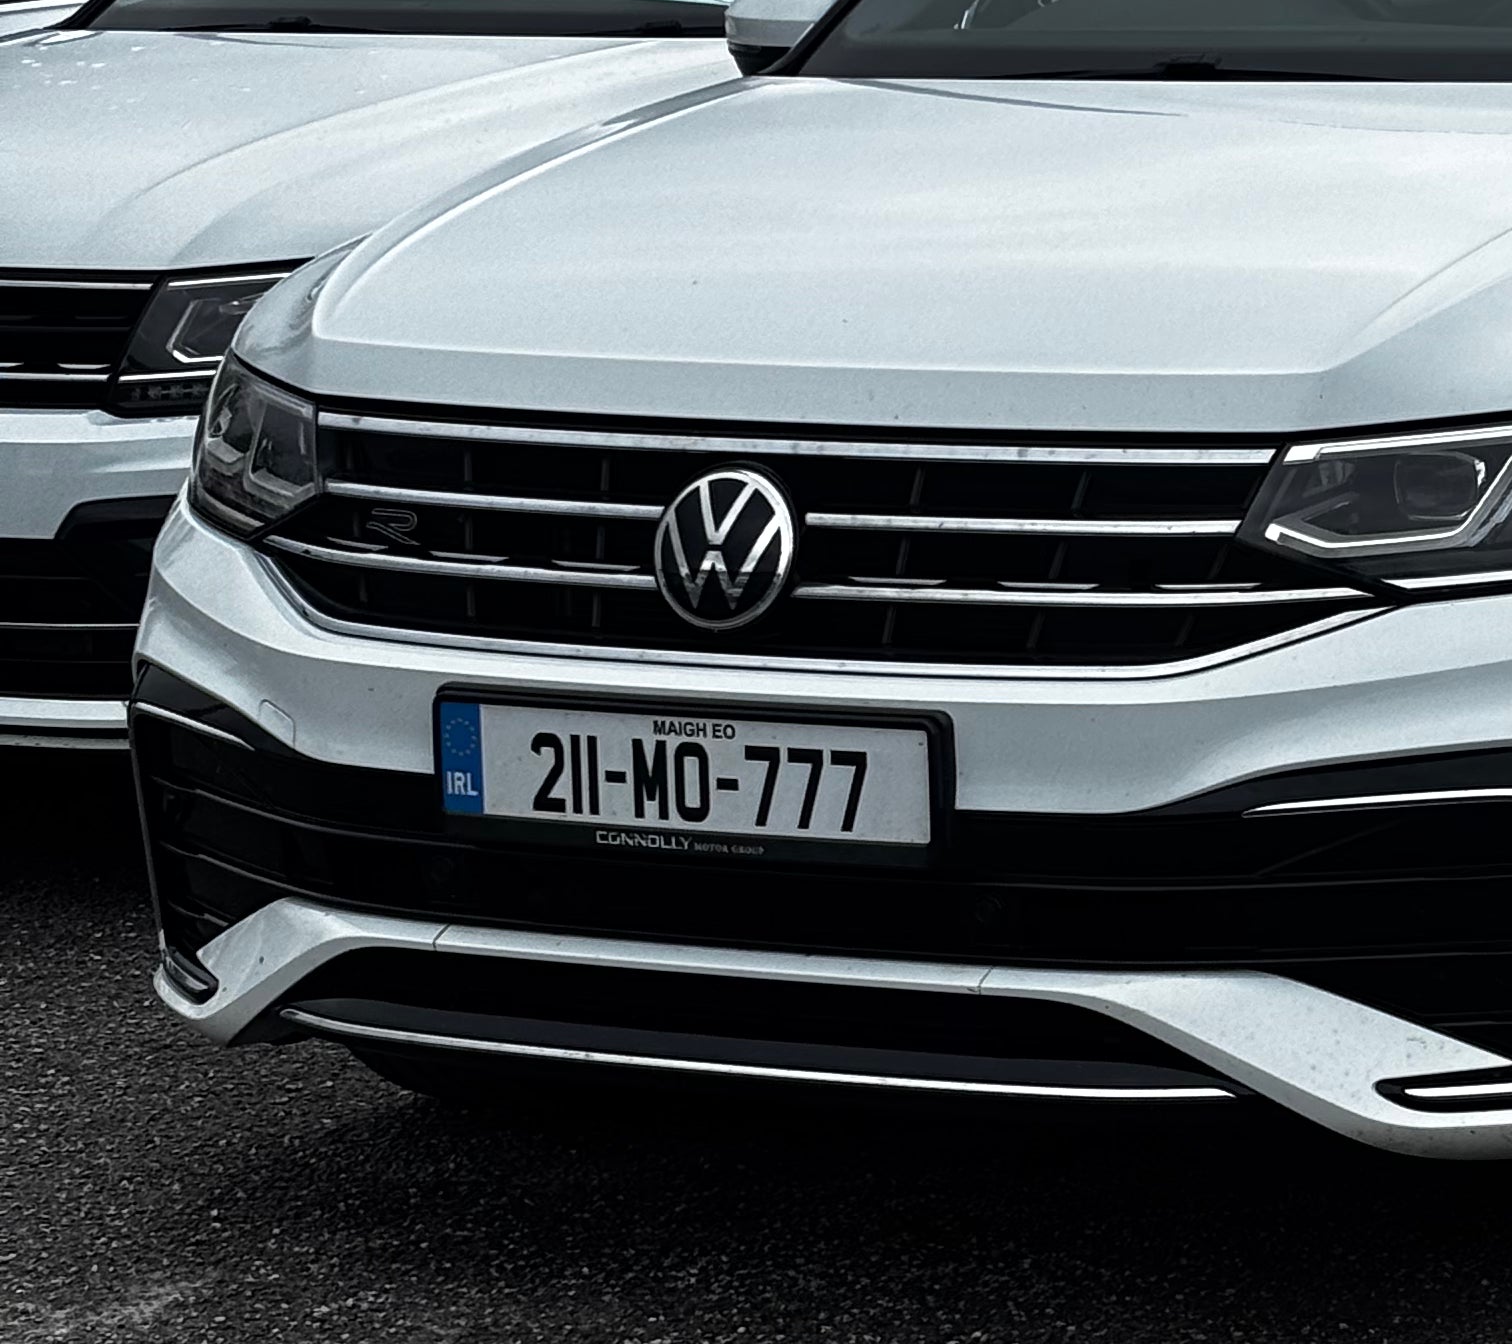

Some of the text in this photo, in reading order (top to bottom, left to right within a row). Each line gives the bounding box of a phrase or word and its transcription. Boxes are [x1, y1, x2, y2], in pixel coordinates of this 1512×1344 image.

[365, 507, 422, 546] R
[653, 720, 736, 740] MAIGH EO
[446, 770, 480, 796] IRL
[530, 732, 868, 832] 211-MO-777
[595, 829, 693, 851] CONNOLLY
